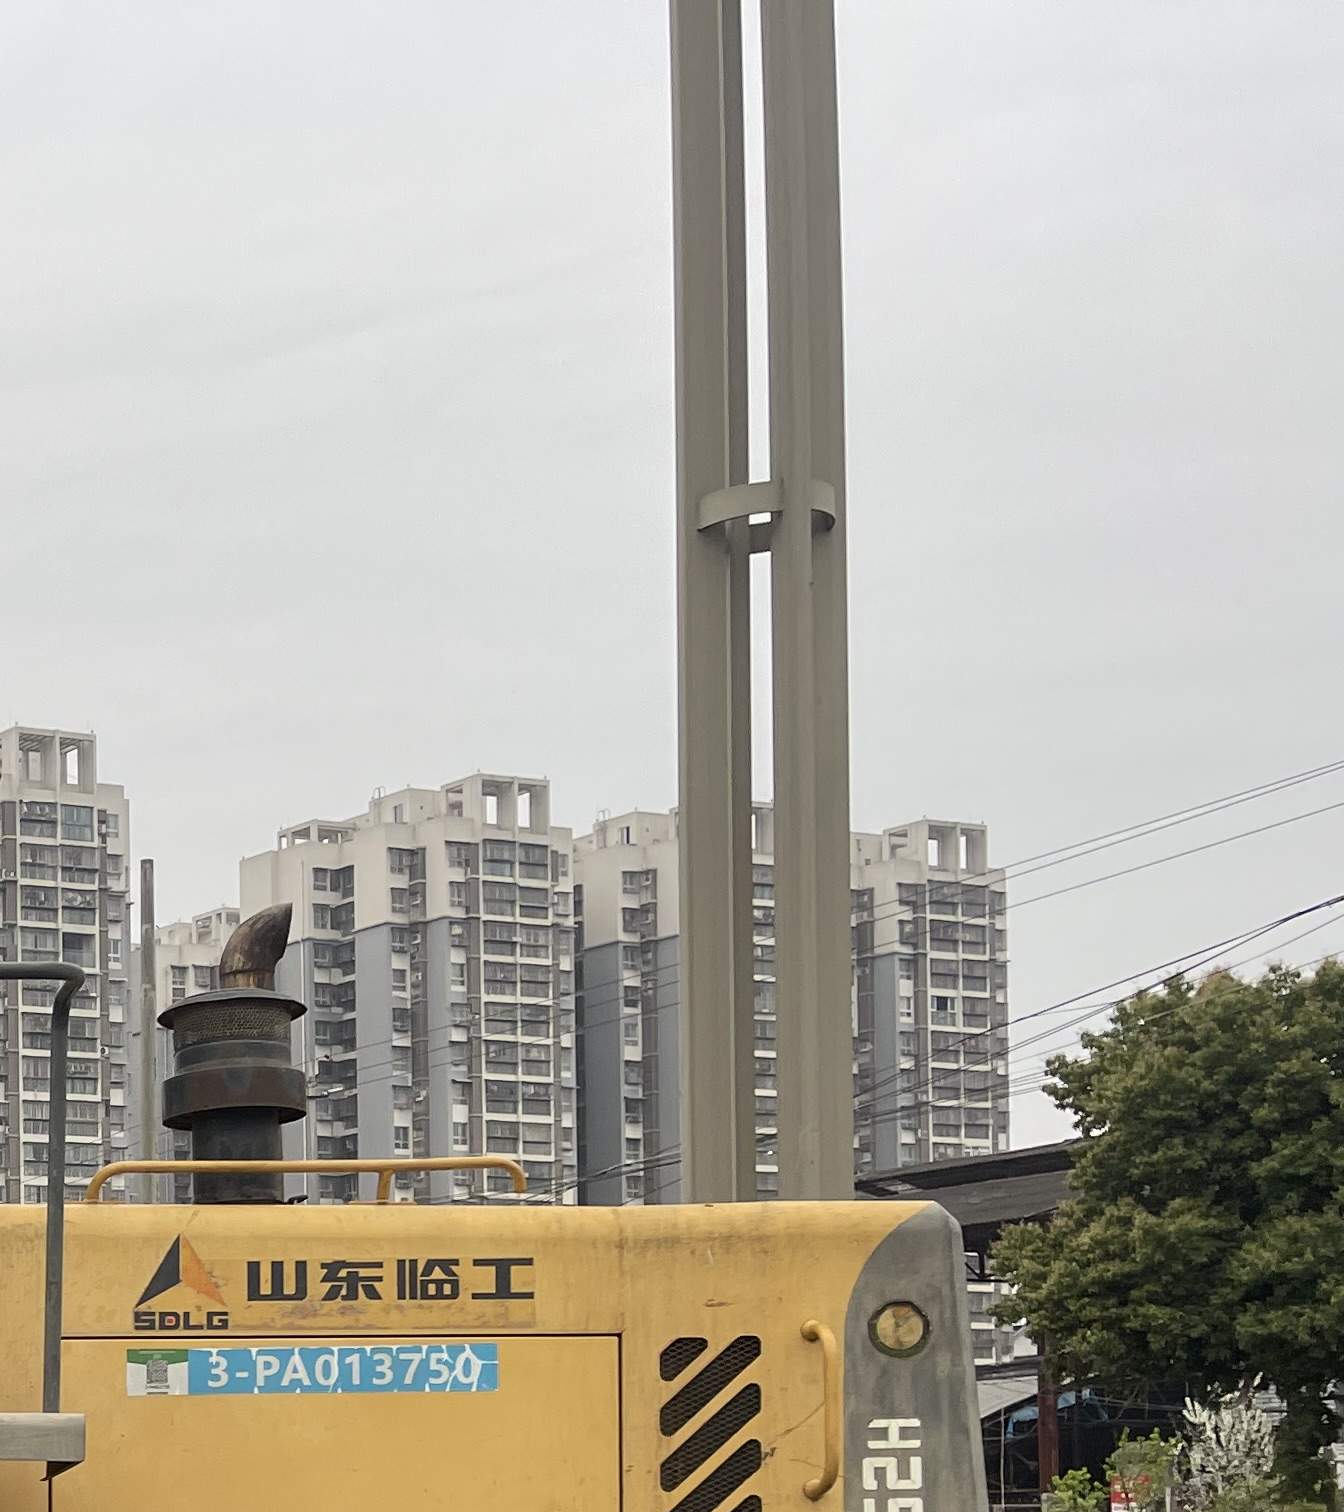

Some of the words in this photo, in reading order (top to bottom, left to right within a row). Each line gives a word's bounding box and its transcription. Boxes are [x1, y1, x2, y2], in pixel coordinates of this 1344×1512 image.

[247, 1258, 534, 1302] 山东临工
[134, 1311, 228, 1330] SDLG
[207, 1352, 479, 1389] 3-PA013750
